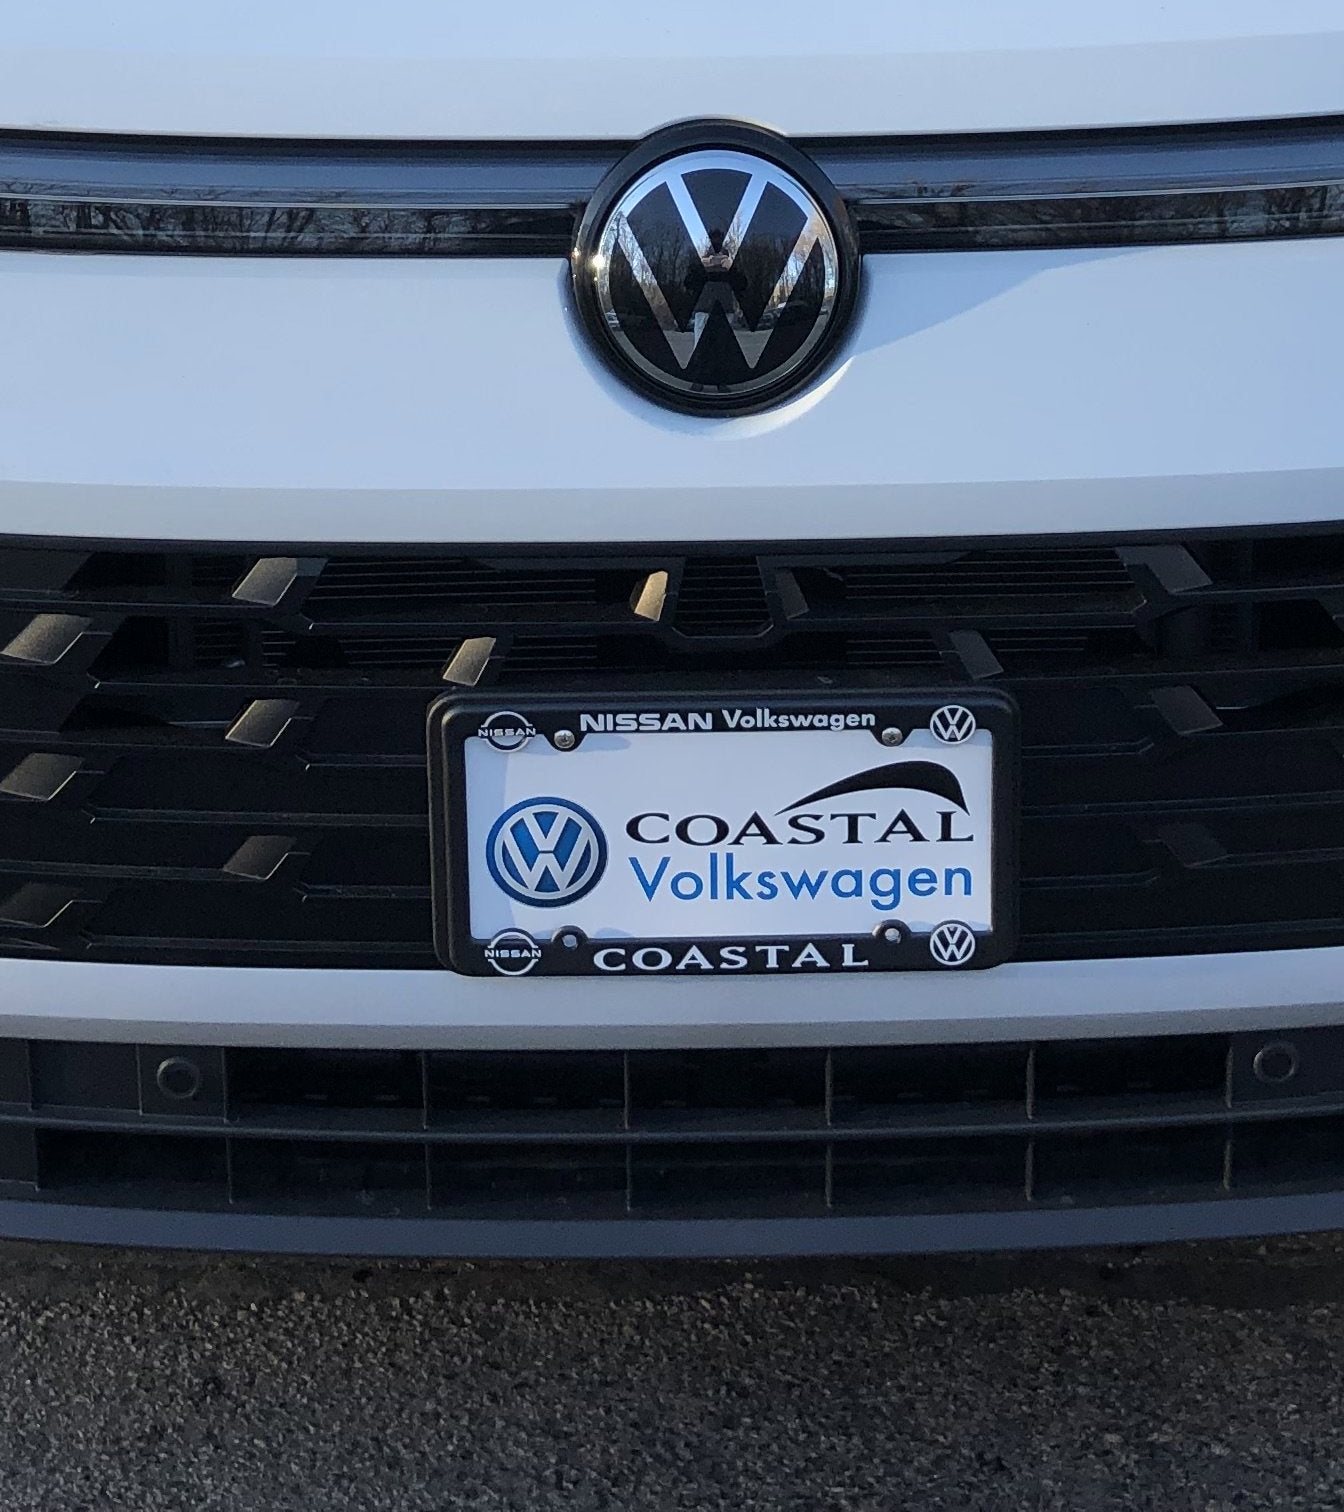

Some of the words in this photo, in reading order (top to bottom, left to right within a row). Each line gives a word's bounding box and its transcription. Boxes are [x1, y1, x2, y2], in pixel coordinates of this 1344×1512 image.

[580, 713, 713, 732] NISSAN
[723, 707, 877, 731] Volkswagen
[478, 728, 537, 738] NISSAN
[625, 809, 975, 846] COASTAL
[629, 852, 973, 911] Volkswagen
[484, 948, 543, 959] NISSAN
[593, 943, 870, 971] COASTAL
